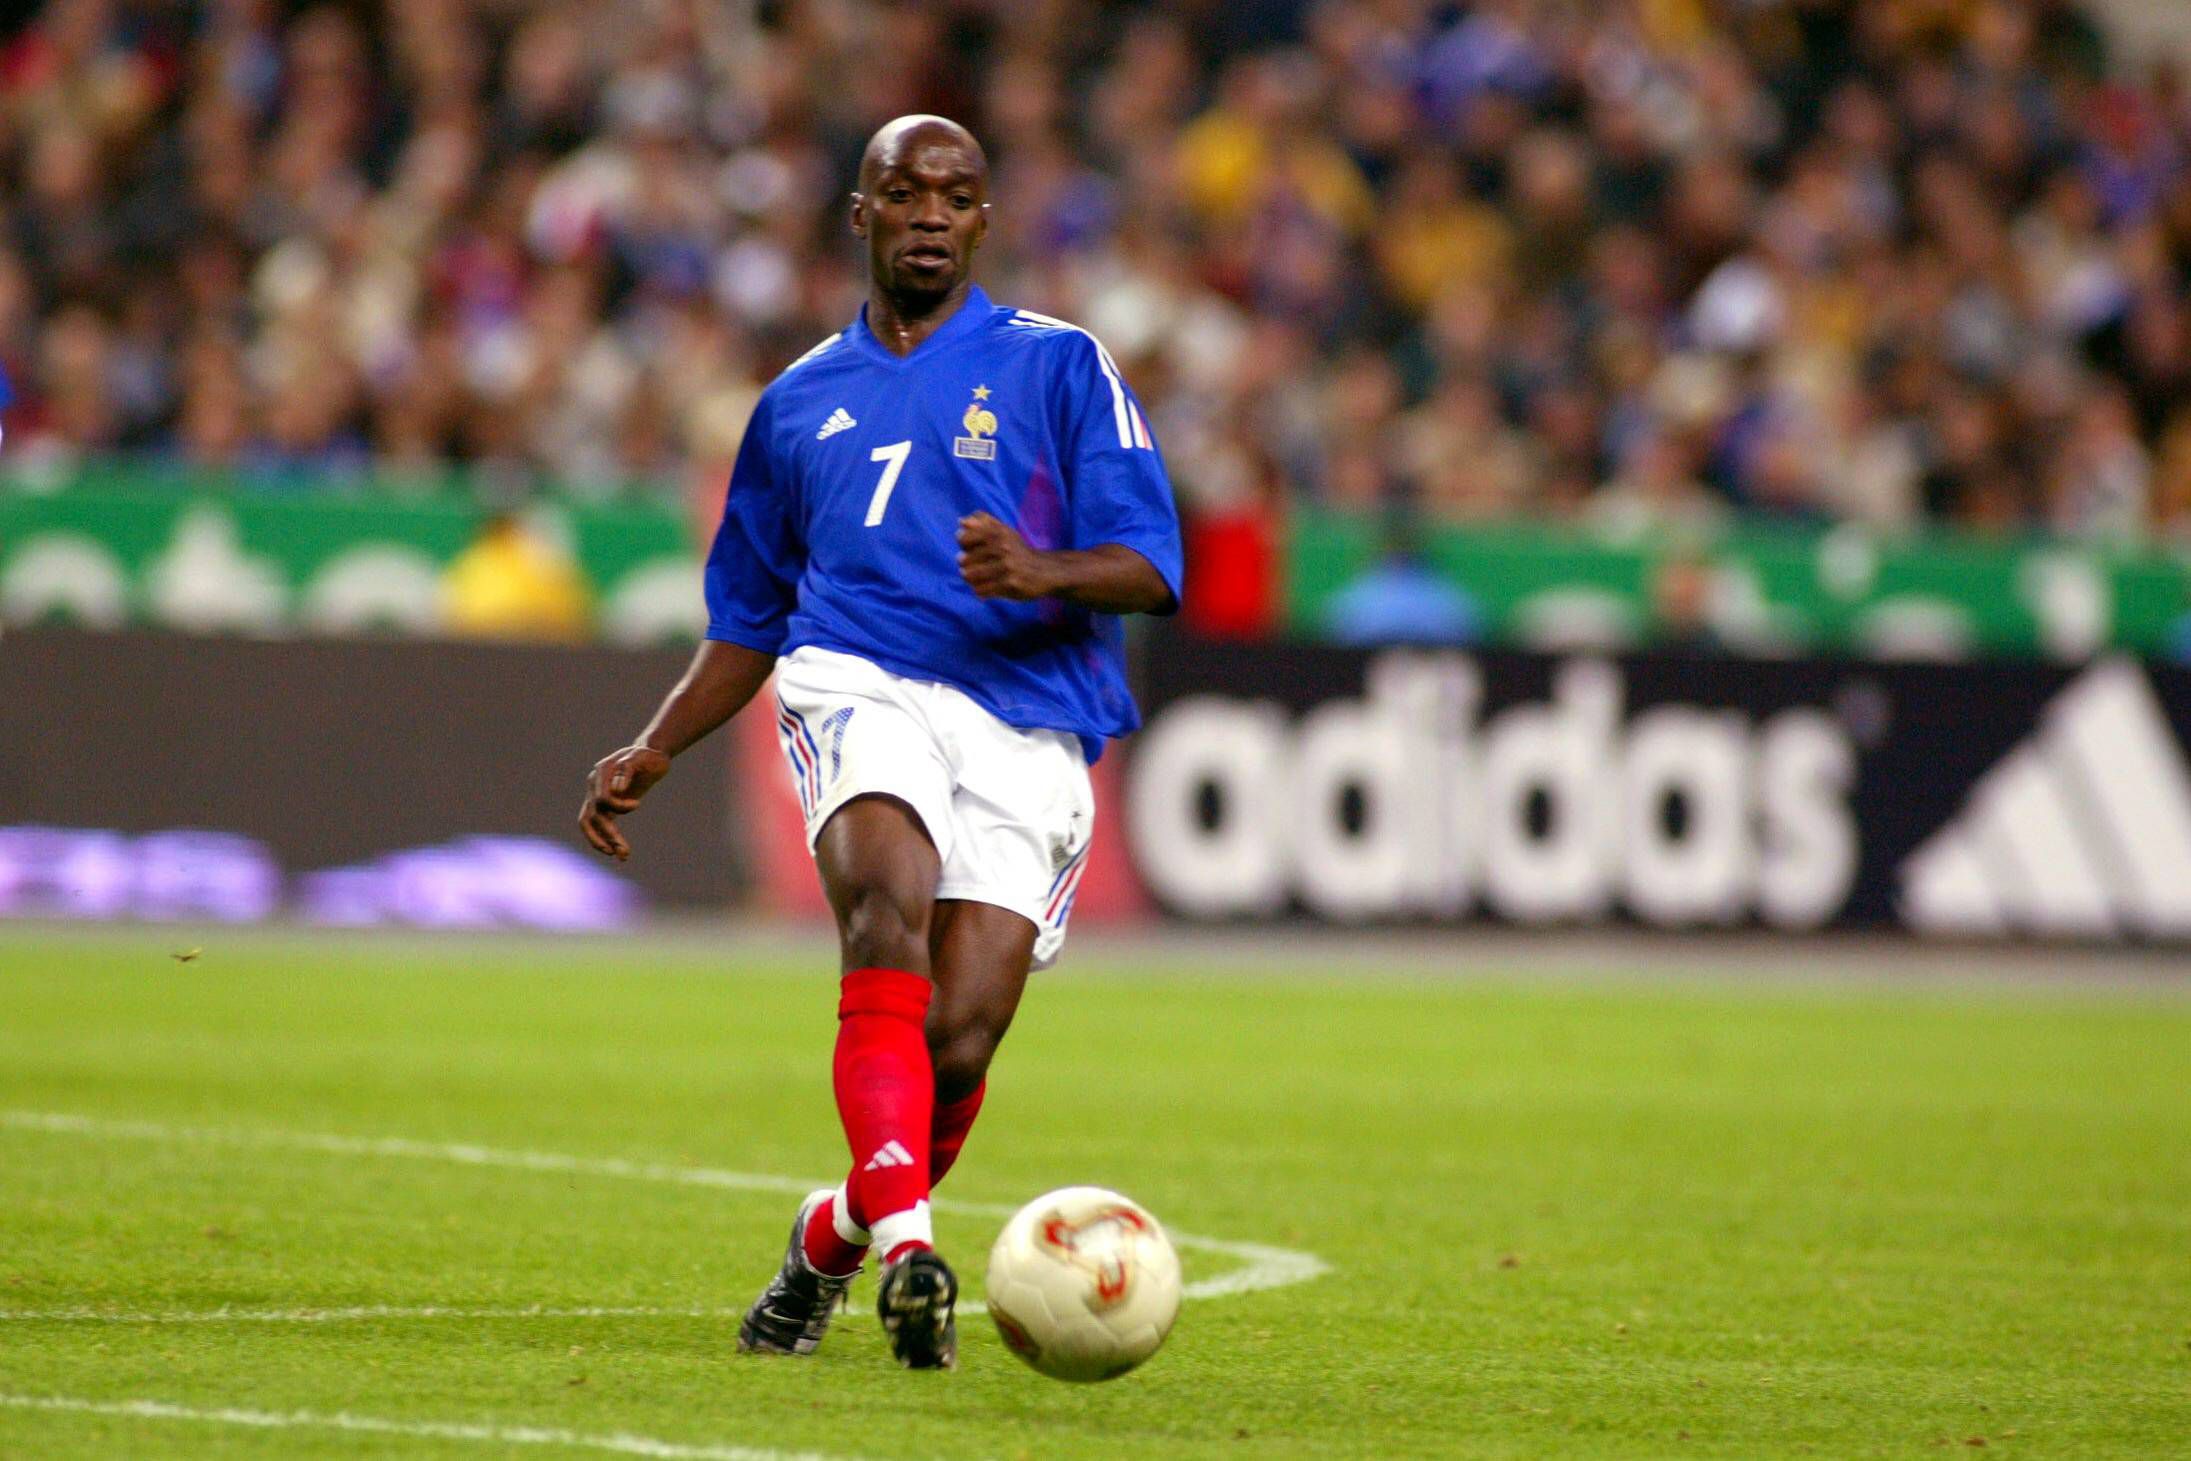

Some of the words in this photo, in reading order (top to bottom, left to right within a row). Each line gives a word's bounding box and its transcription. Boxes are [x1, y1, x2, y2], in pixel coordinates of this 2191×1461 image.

[864, 440, 912, 527] 7
[821, 706, 855, 784] 7
[1127, 650, 1857, 927] adidas
